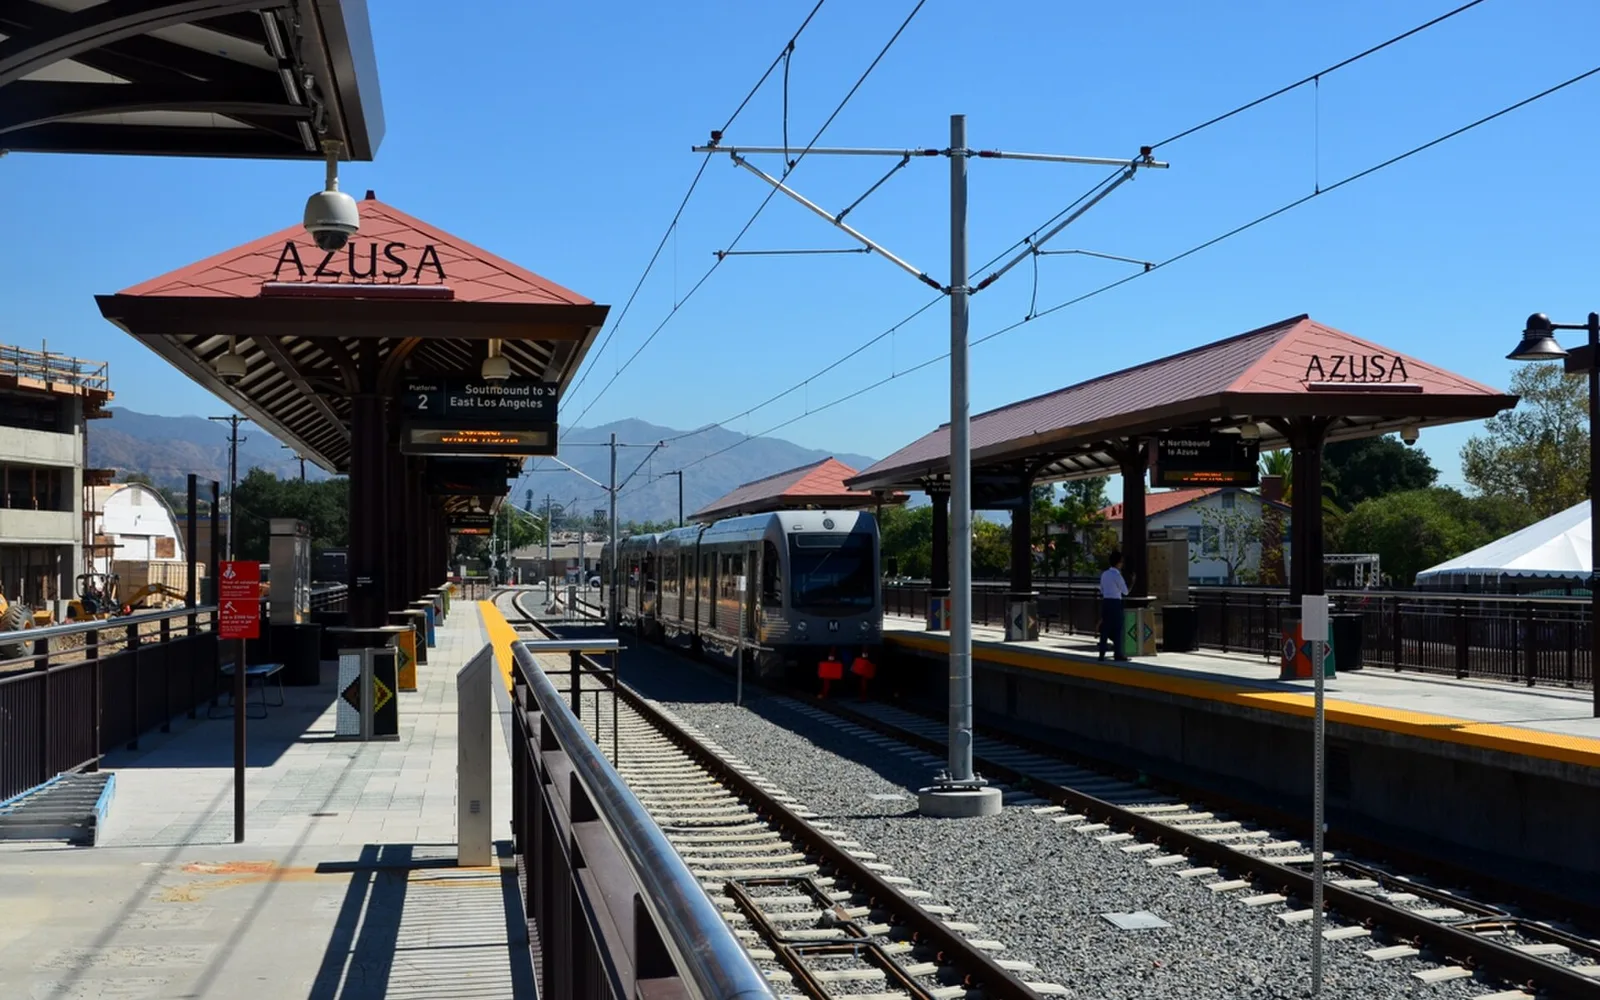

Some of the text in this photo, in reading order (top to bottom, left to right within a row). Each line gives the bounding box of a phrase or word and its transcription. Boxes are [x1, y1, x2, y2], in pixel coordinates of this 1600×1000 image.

[273, 241, 447, 279] AZUSA
[1305, 354, 1409, 379] AZUSA
[465, 384, 543, 396] Southbound to
[418, 393, 428, 410] 2
[450, 397, 543, 410] East Los Angeles
[1167, 439, 1211, 447] Northbound
[1168, 448, 1199, 456] to Azusa
[1242, 446, 1248, 458] 1
[829, 621, 838, 631] M
